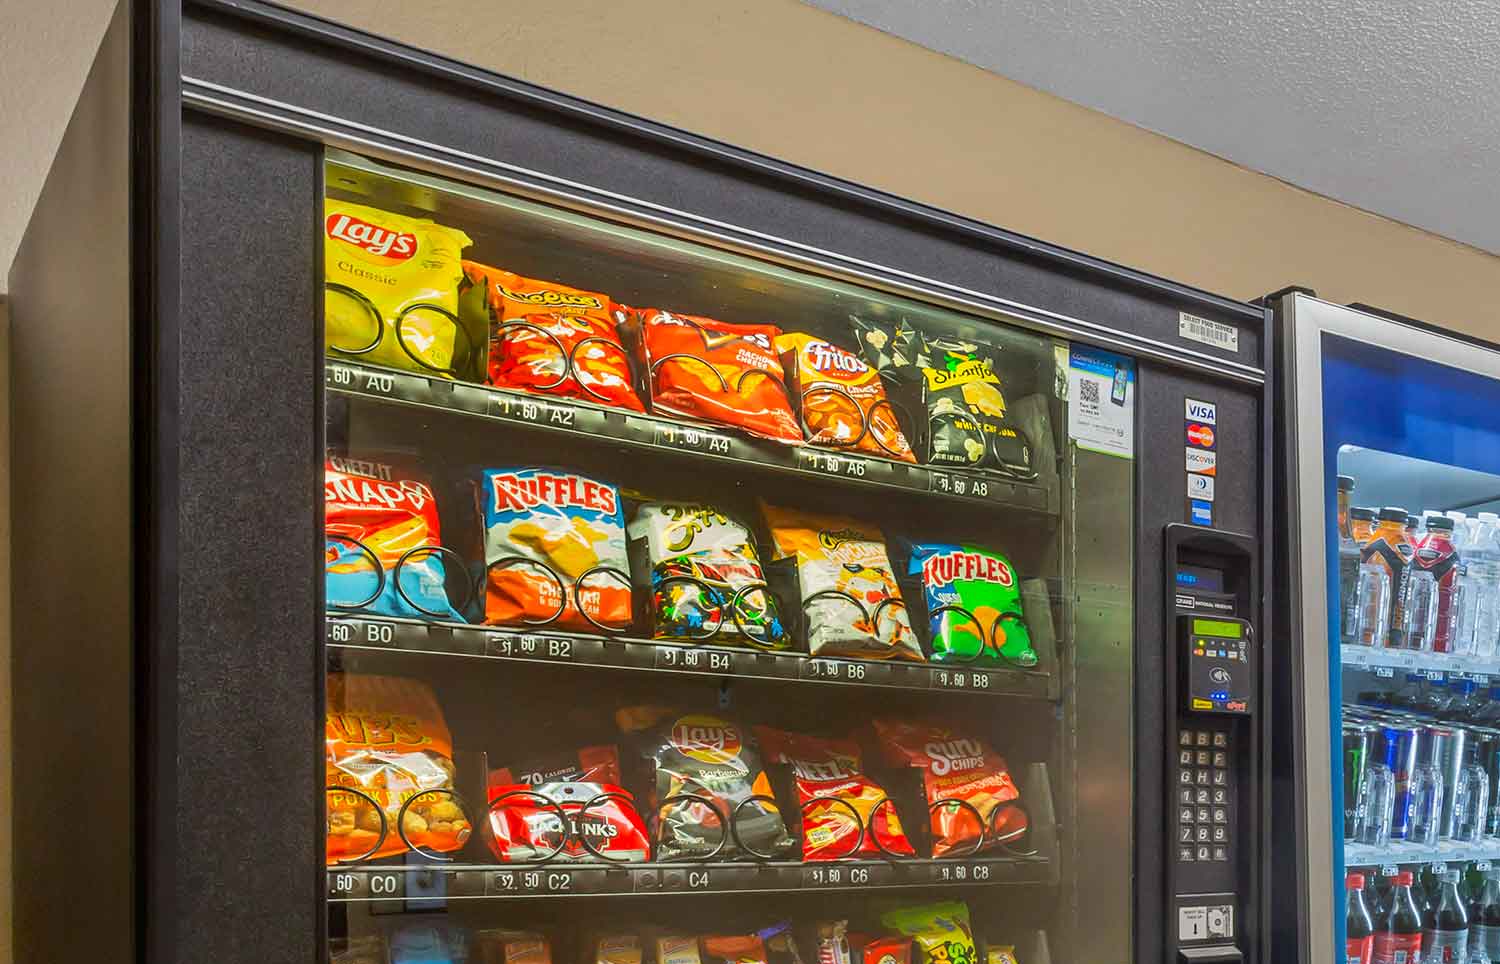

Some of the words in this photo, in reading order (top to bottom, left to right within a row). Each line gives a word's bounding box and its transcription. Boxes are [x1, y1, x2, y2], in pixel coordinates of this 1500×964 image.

[332, 215, 414, 257] Lay's
[337, 260, 399, 286] Classic
[803, 341, 869, 373] Fritos
[366, 374, 394, 393] A0
[550, 409, 575, 426] A2
[1190, 406, 1215, 420] VISA
[709, 439, 729, 453] A4
[1188, 454, 1215, 465] DISCOVER
[847, 460, 866, 477] A6
[493, 474, 617, 516] RUFFLES
[972, 482, 988, 497] A8
[925, 553, 1012, 586] RUFFLES
[368, 625, 393, 643] B0
[549, 640, 571, 657] B2
[711, 654, 729, 669] B4
[848, 665, 865, 680] B6
[973, 673, 989, 688] B8
[690, 872, 709, 887] C4
[851, 868, 868, 883] C6
[973, 866, 989, 880] C8
[371, 876, 396, 893] C0
[548, 874, 570, 890] C2
